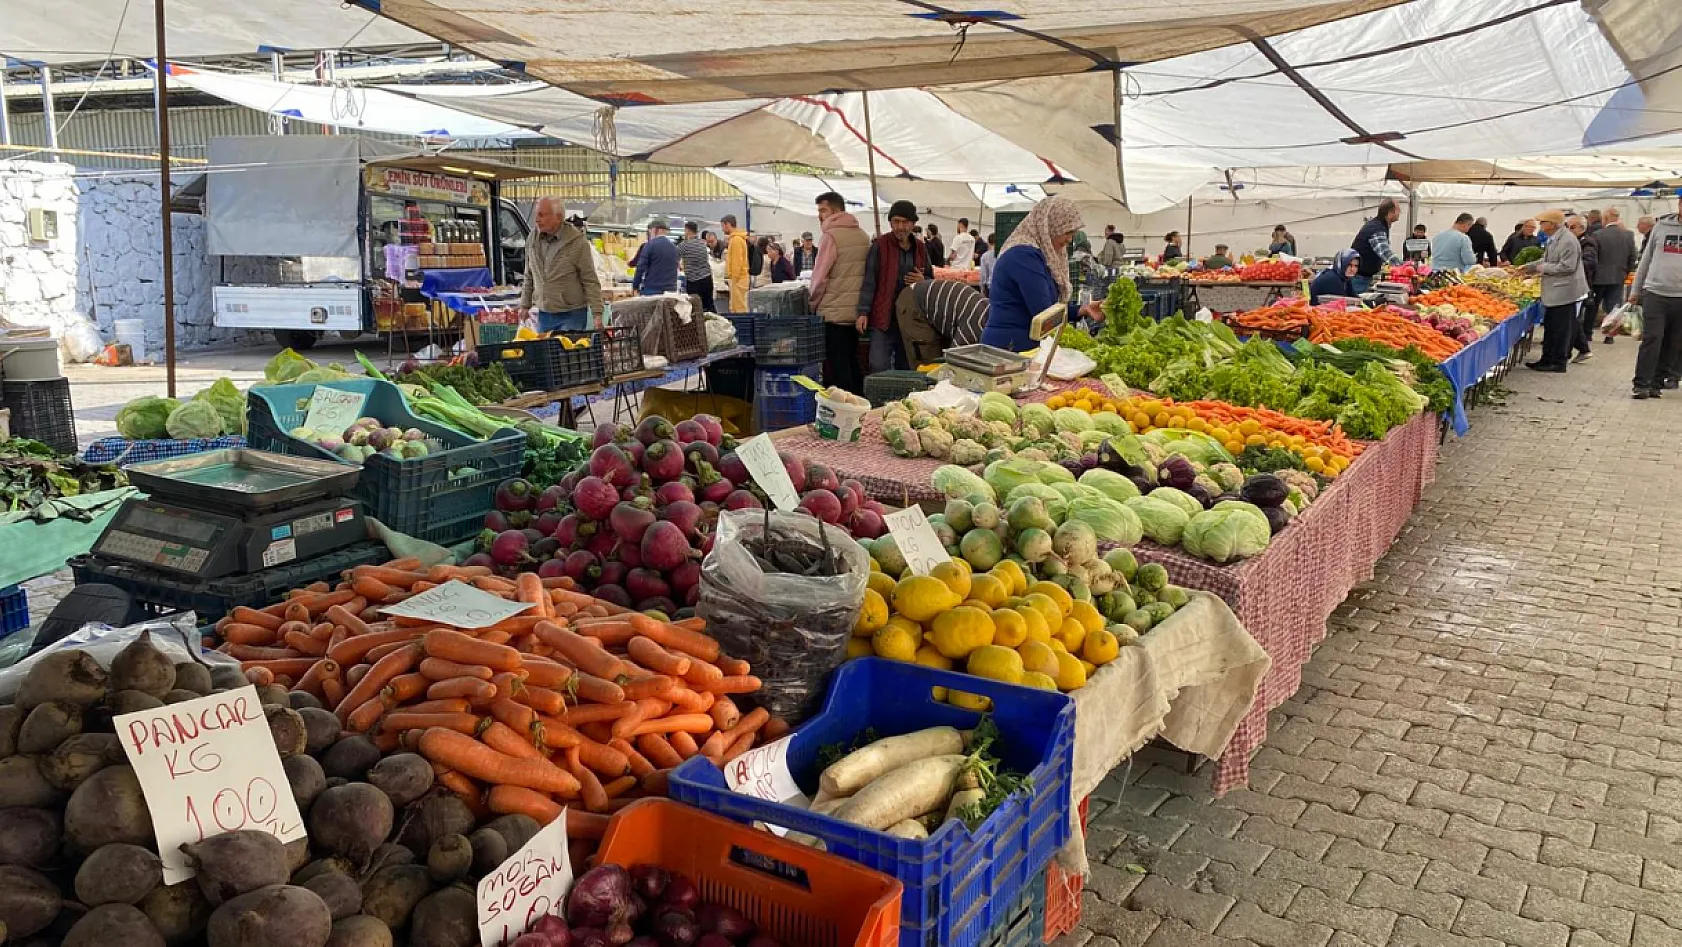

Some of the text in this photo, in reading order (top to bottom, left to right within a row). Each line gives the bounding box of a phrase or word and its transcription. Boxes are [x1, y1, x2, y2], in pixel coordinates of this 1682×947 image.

[412, 172, 428, 187] SÜT
[129, 697, 263, 755] PANCAR
[164, 742, 222, 780] KG
[482, 848, 545, 900] MOR
